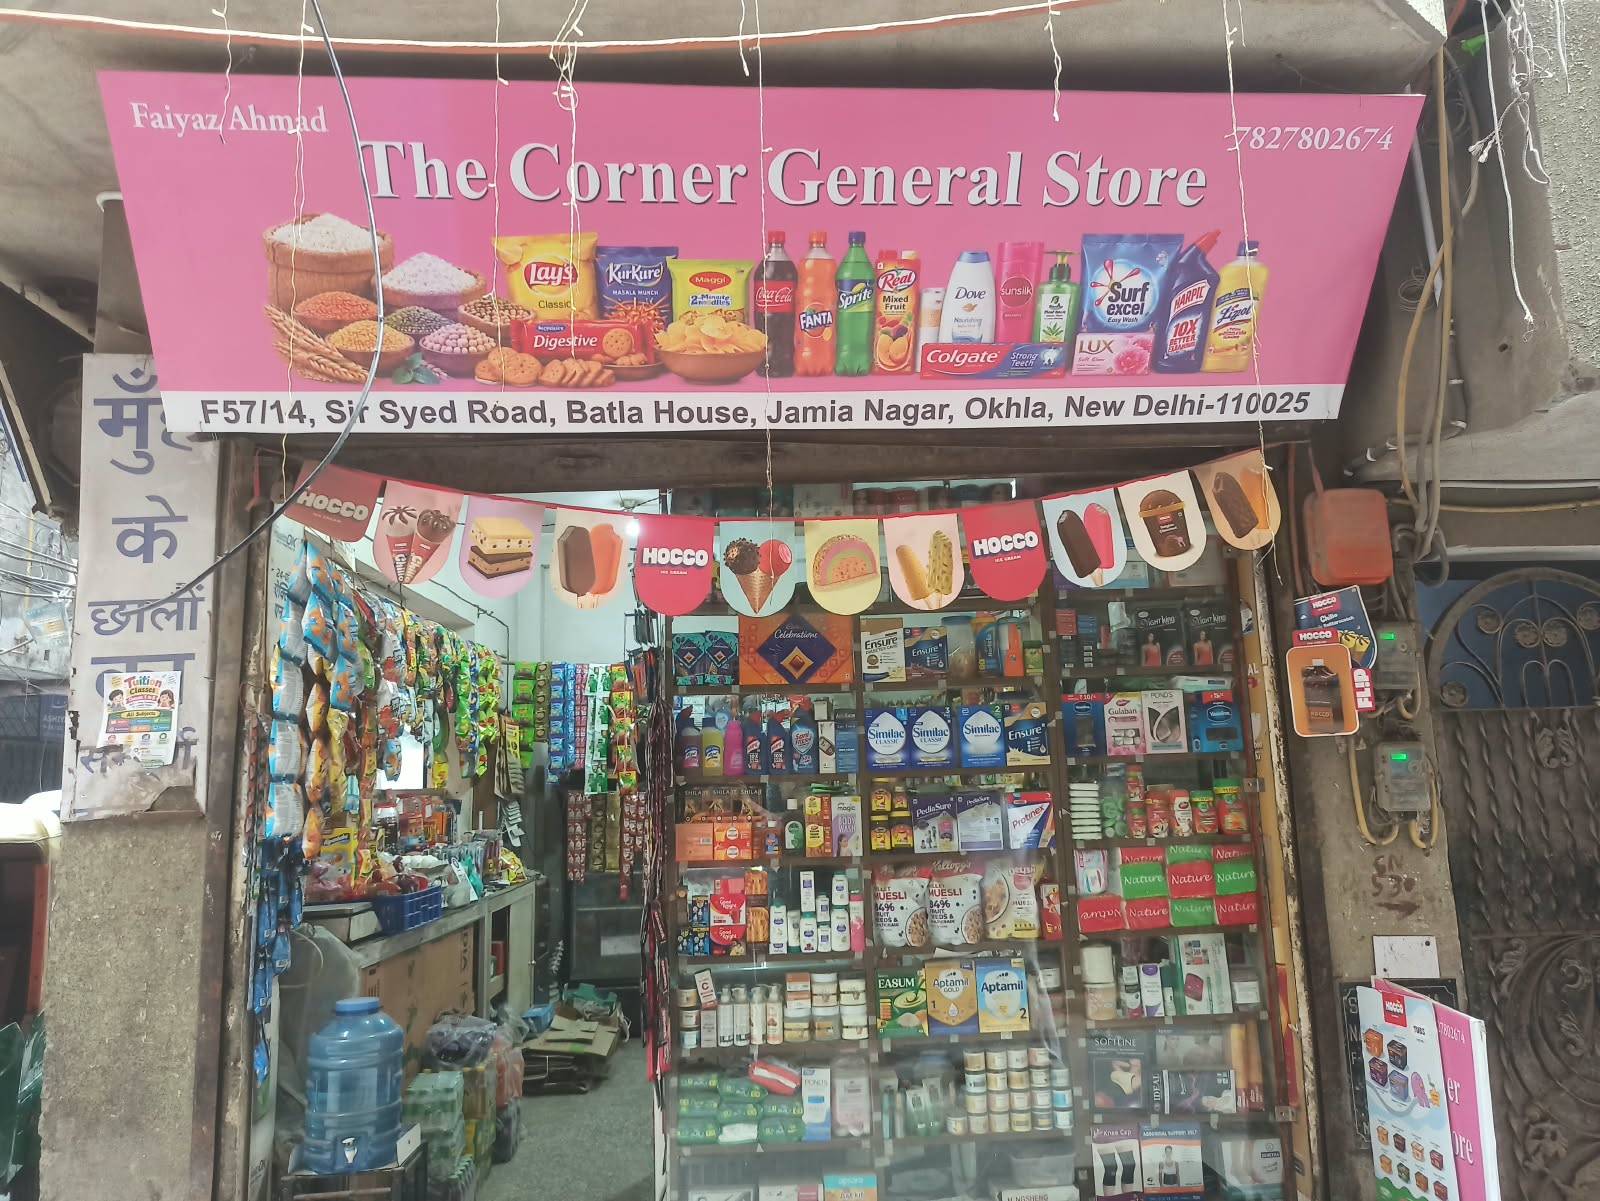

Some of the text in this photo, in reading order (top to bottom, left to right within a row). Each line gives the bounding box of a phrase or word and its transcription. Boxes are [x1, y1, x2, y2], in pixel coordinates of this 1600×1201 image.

[130, 103, 328, 138] Faiyaz Ahmad
[1234, 125, 1394, 152] 7827802674
[359, 141, 1207, 208] The Corner General Store
[528, 262, 575, 286] Lay's
[881, 269, 914, 290] Real
[955, 287, 987, 300] Dove
[1001, 286, 1033, 297] sunsilk
[1108, 281, 1150, 303] Surf
[1173, 283, 1205, 310] HARPIC
[538, 299, 572, 309] Classic
[839, 288, 874, 310] Sprite
[882, 294, 909, 304] Mixed
[885, 303, 906, 312] Fruit
[1106, 303, 1146, 317] excel
[799, 311, 833, 331] FANTA
[1173, 319, 1199, 337] 10X
[533, 334, 598, 350] Digestive
[1079, 340, 1115, 354] LUX
[926, 349, 997, 368] Colgate
[1010, 351, 1039, 362] Strong
[201, 390, 1311, 433] F57/14, Sir Syed Road, Batla House, Jamia Nagar, Okhla, New Delhi-110025
[297, 489, 369, 522] HOCCO
[111, 495, 189, 565] के
[972, 529, 1040, 557] HOCCO
[642, 547, 709, 567] HOCCO
[1006, 554, 1022, 562] CREAM
[1312, 596, 1337, 609] HOCCO
[1299, 630, 1333, 641] HOCCO
[864, 636, 898, 651] Ensure
[911, 645, 939, 657] Ensure
[124, 676, 162, 688] Tuition
[130, 687, 156, 695] Classes
[868, 727, 905, 740] Similac
[912, 727, 950, 740] Similac
[964, 723, 1001, 735] Similac
[1008, 726, 1043, 741] Ensure
[916, 802, 953, 818] PediaSure
[1012, 806, 1045, 829] Protinex
[1124, 873, 1164, 885] Nature
[1171, 873, 1213, 885] Nature
[1216, 869, 1256, 881] Nature
[928, 888, 962, 897] MUESLI
[1129, 906, 1169, 916] Nature
[1174, 904, 1213, 913] Nature
[877, 976, 915, 989] EASUM
[932, 977, 969, 988] Aptamil
[981, 980, 1024, 994] Aptamil
[1019, 1008, 1027, 1020] 2
